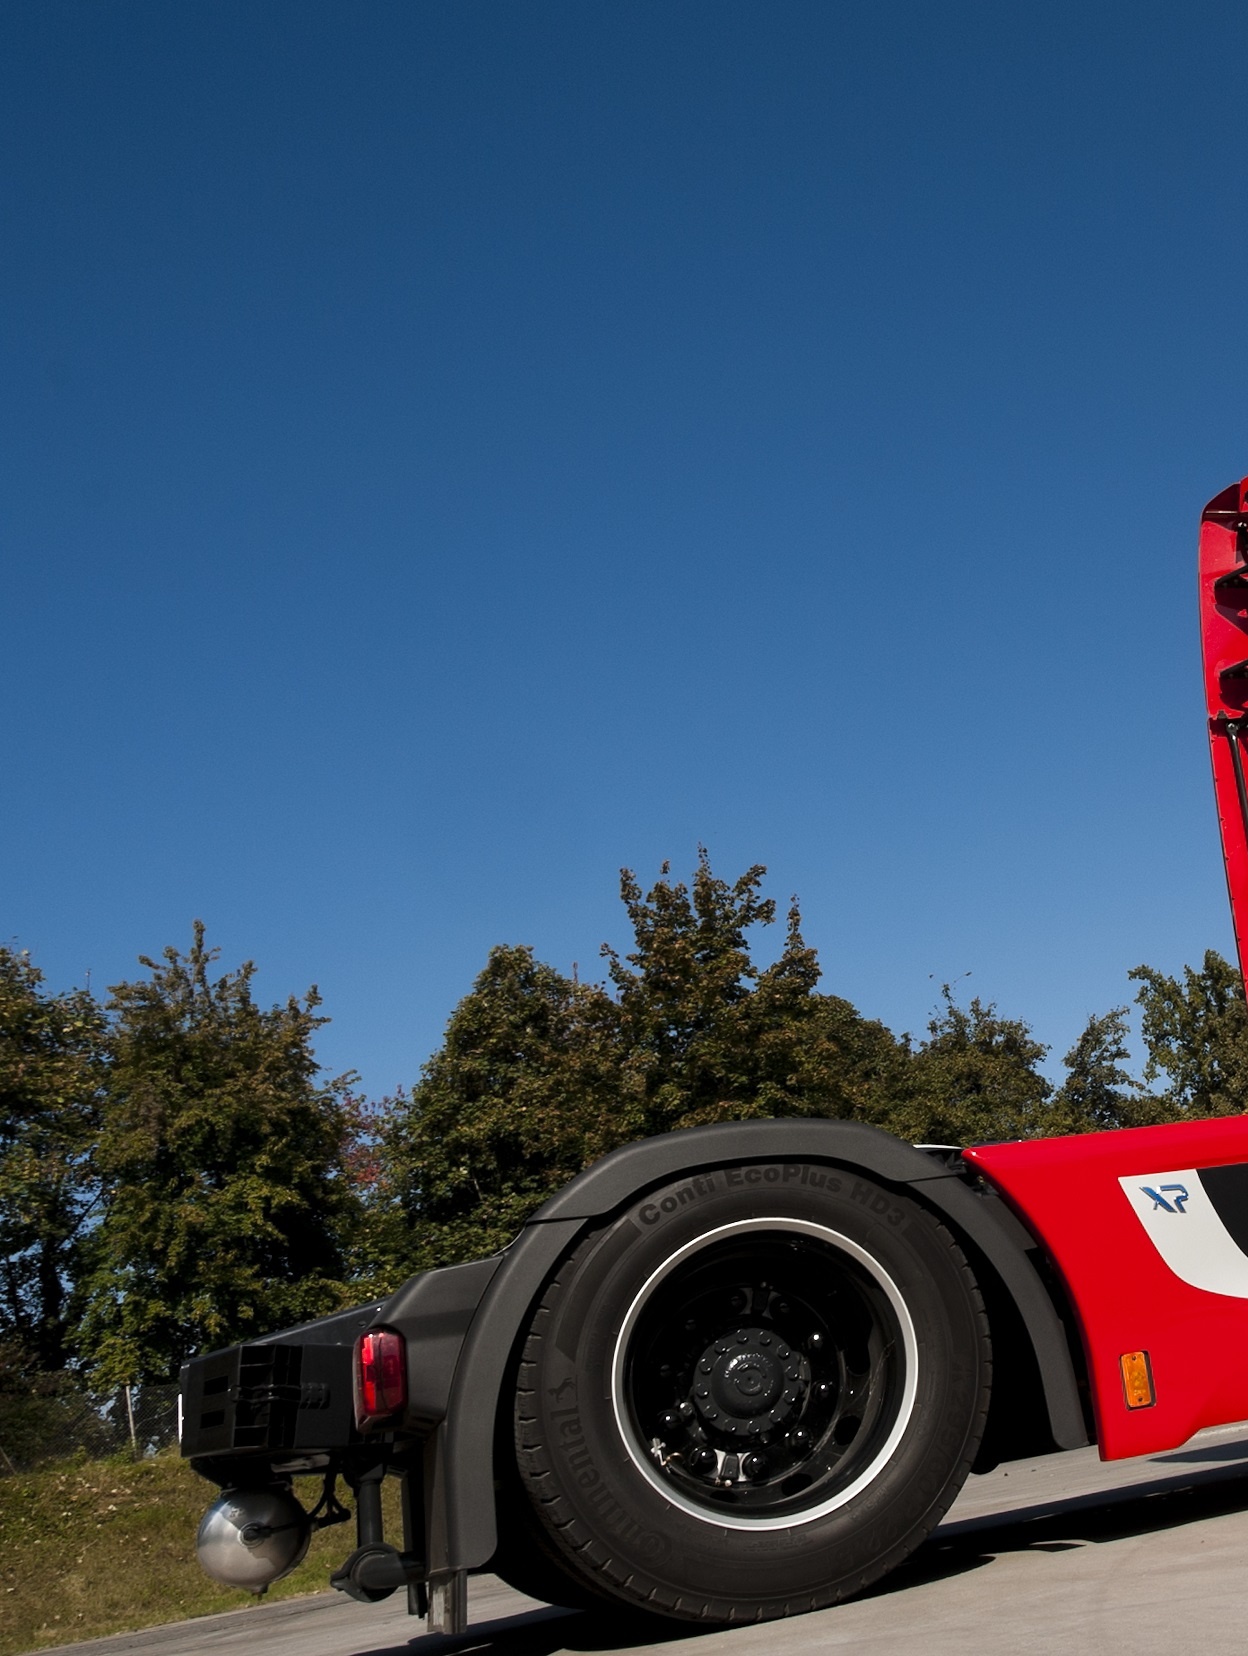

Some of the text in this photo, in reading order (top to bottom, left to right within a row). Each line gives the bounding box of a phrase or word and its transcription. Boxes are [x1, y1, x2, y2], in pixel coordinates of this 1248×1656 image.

[638, 1163, 906, 1226] Conti EcoPlus HD3
[1139, 1184, 1189, 1213] XP
